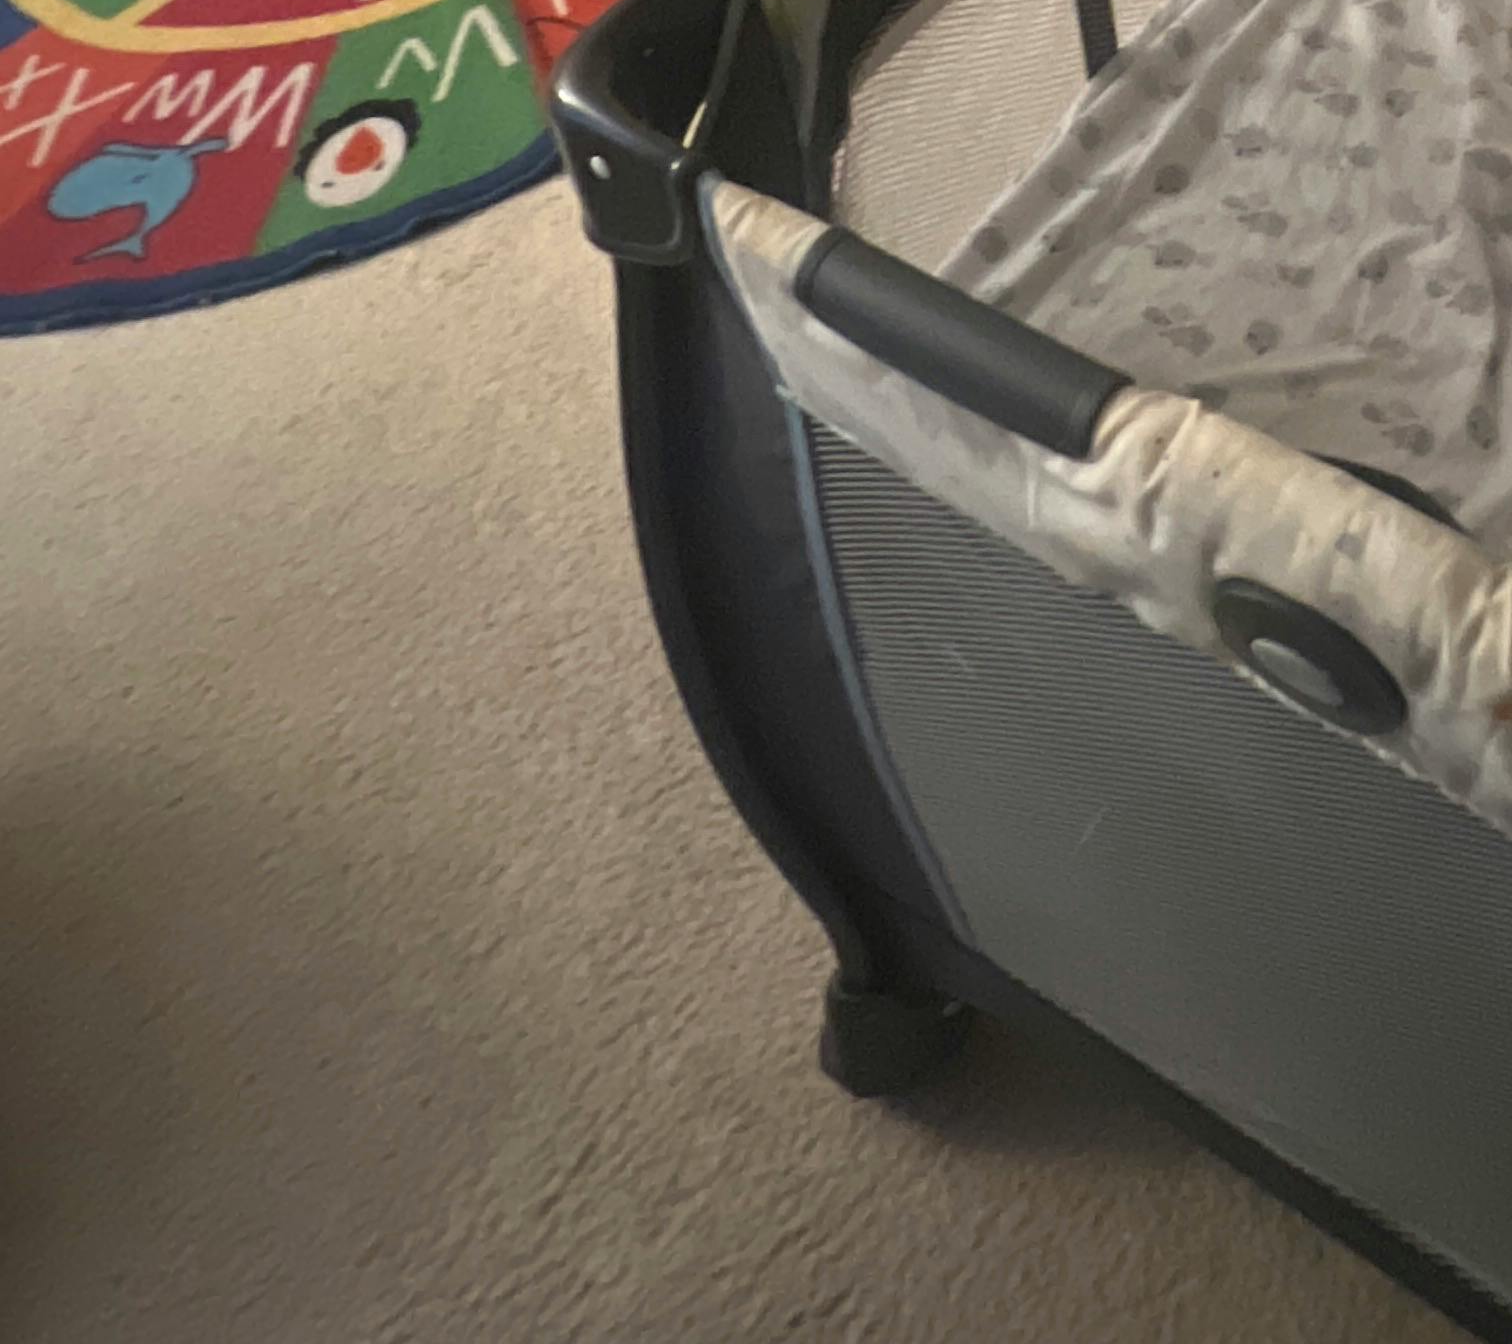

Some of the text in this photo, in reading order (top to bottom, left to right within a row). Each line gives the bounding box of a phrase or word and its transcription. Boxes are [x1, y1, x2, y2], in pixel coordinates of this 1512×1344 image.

[375, 5, 519, 103] Vv
[0, 54, 138, 168] Xx
[121, 61, 316, 153] Ww
